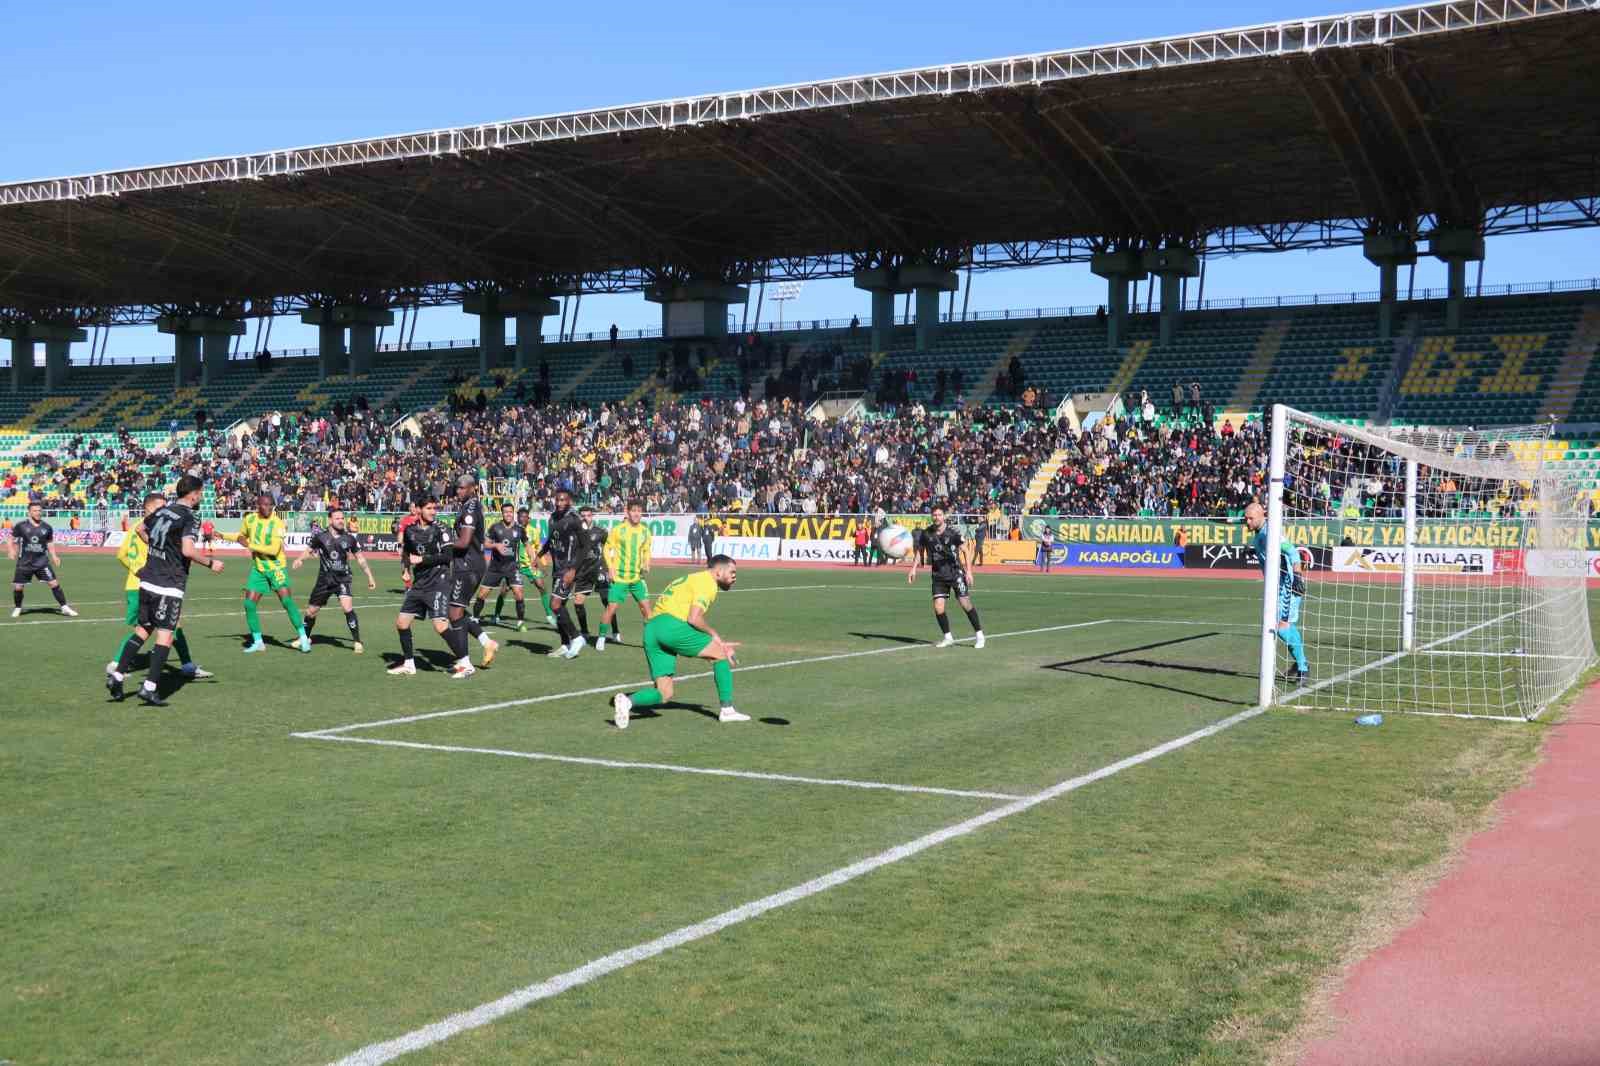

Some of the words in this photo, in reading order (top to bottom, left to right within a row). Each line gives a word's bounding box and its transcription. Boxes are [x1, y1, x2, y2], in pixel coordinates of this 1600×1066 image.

[1059, 524, 1090, 541] SEN
[1096, 524, 1165, 543] SAHADA
[1242, 525, 1334, 547] FMAYI,
[1381, 522, 1518, 546] YAATACAĞIZ
[790, 550, 821, 559] HAS
[1079, 551, 1172, 564] KASAPOĞLU
[1373, 552, 1483, 565] AYINLAR
